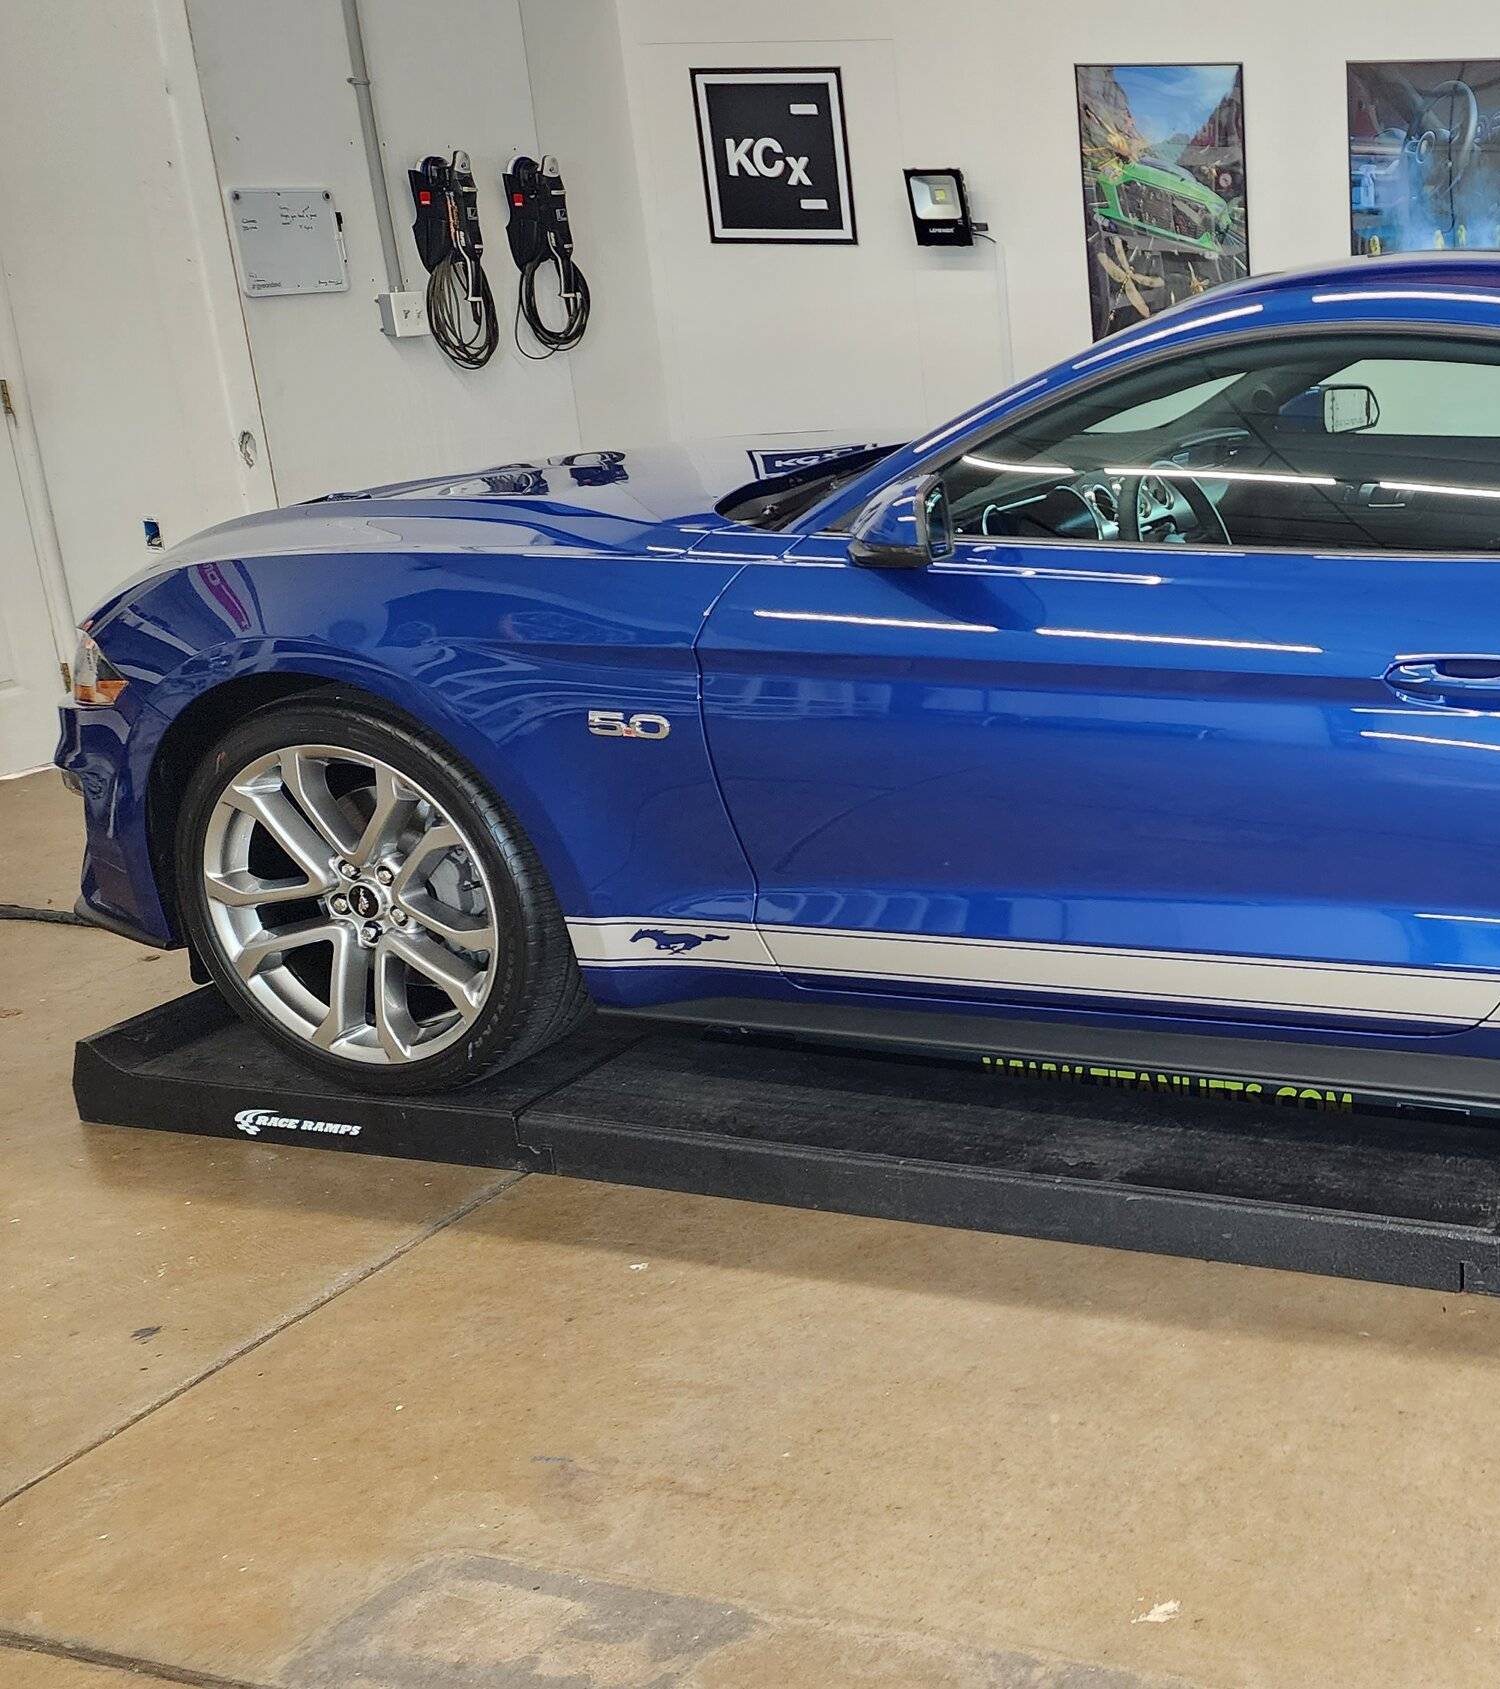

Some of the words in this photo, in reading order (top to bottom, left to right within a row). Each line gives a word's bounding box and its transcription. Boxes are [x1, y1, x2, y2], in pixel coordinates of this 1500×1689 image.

[725, 137, 813, 186] KCx
[588, 710, 671, 740] 5.0
[255, 1115, 300, 1130] RACE
[300, 1120, 362, 1136] RAMPS
